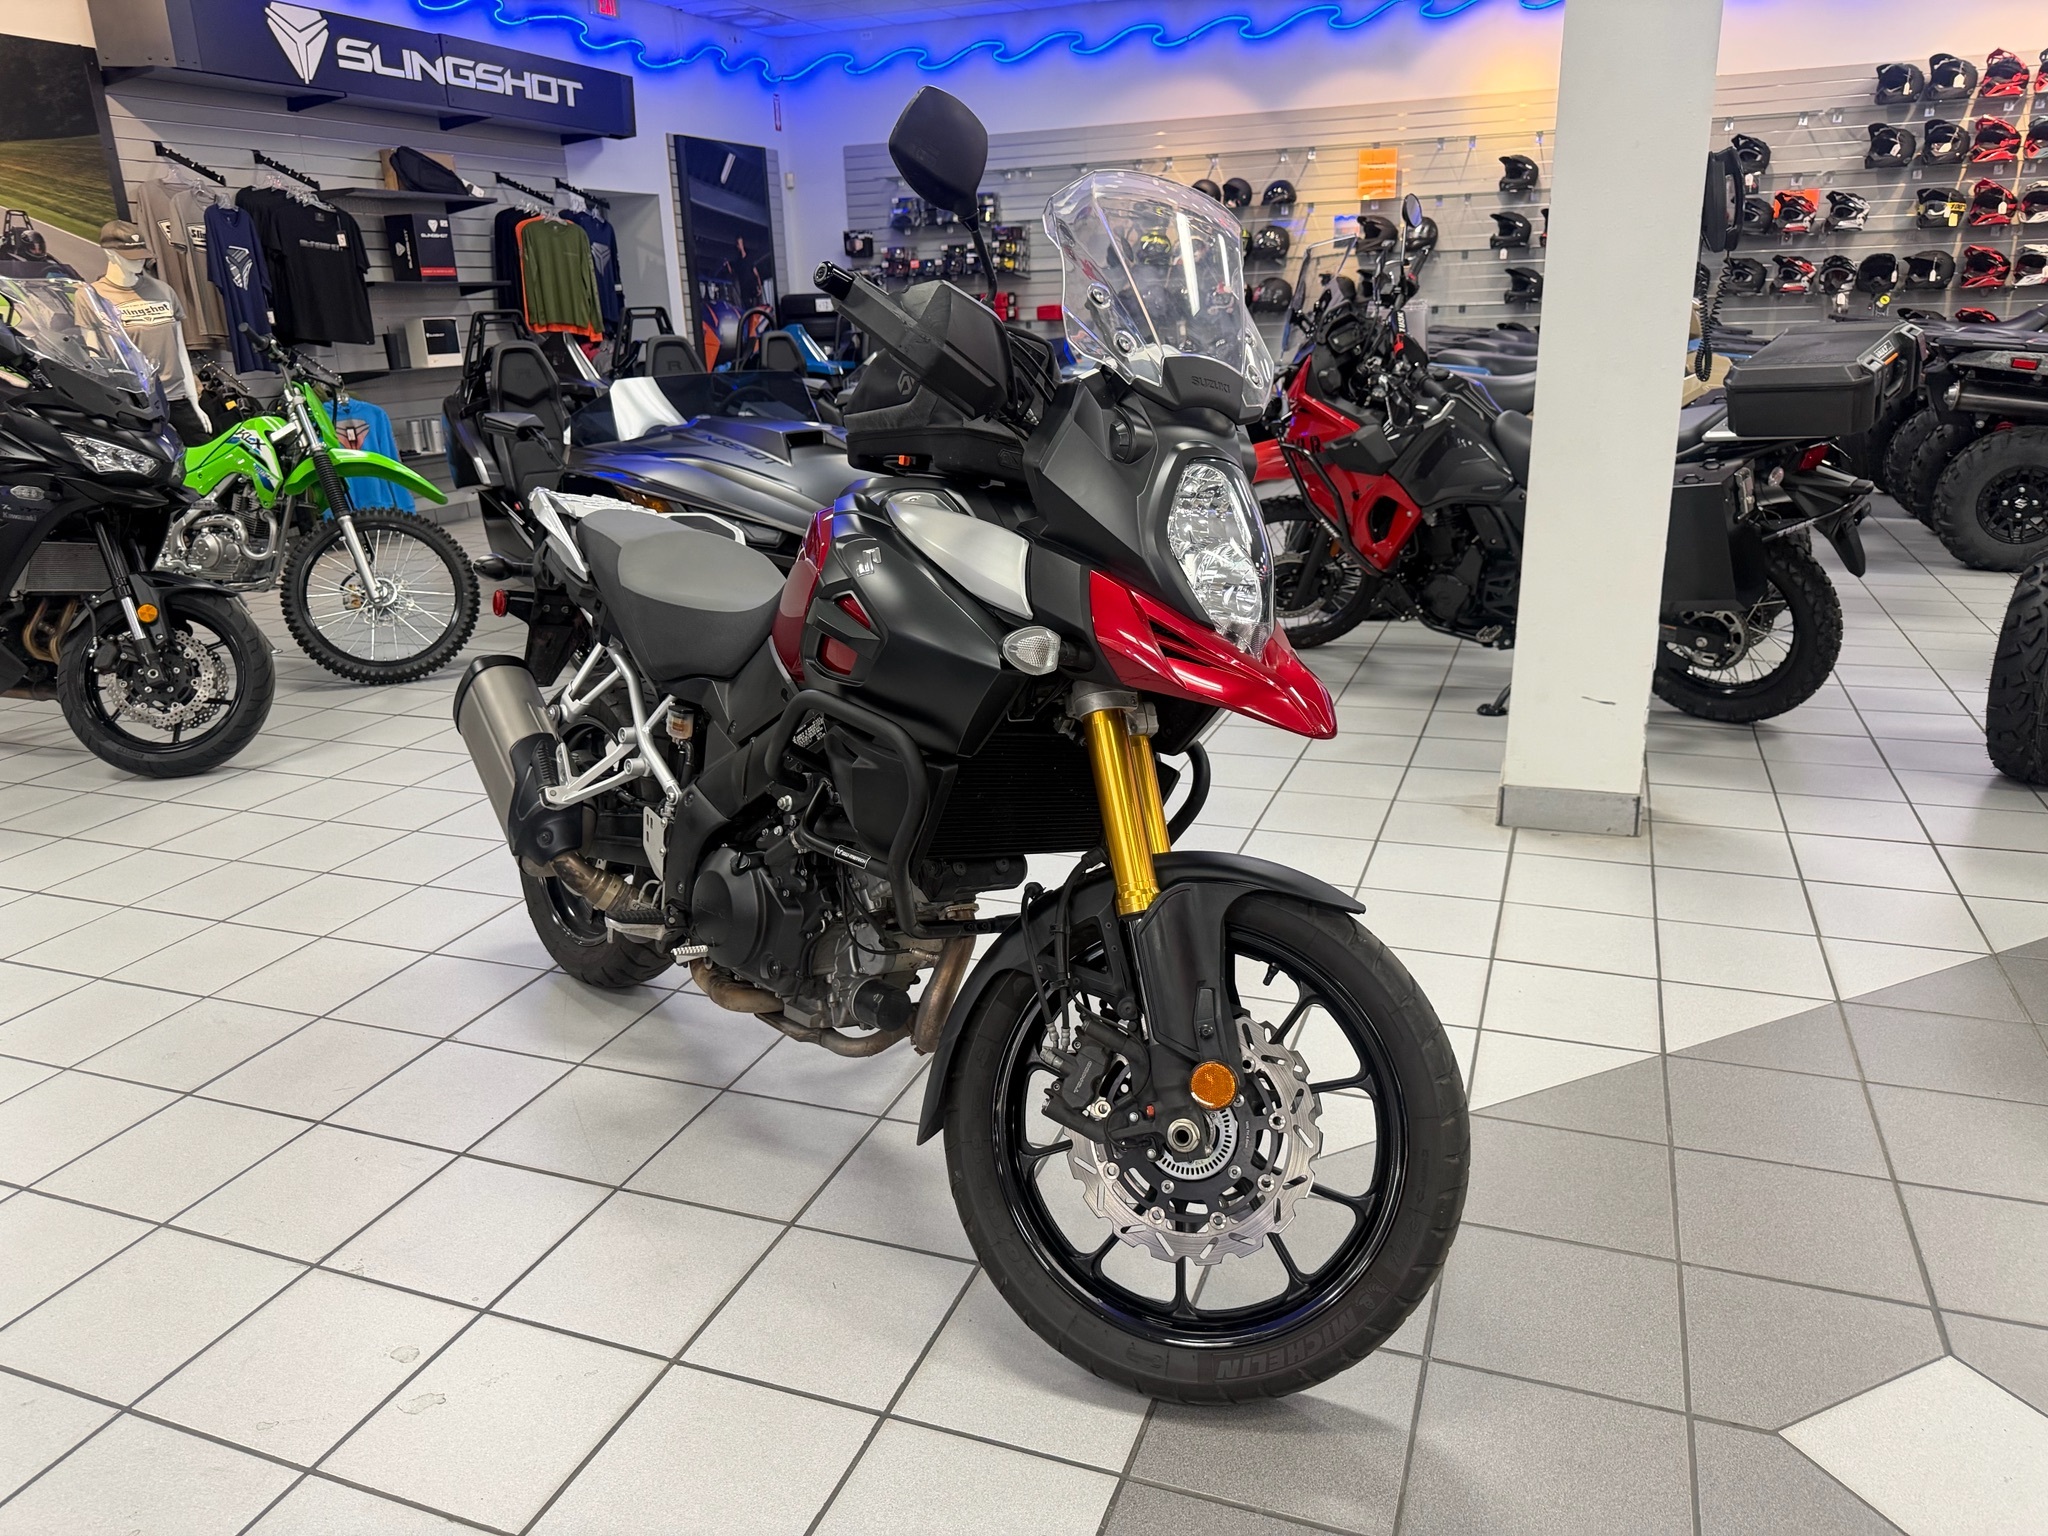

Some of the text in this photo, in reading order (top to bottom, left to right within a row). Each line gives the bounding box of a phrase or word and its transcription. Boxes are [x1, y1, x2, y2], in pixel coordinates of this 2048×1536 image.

[337, 37, 583, 107] SLINGSHOT
[1190, 375, 1231, 394] SUZUKI
[1216, 1310, 1358, 1380] MICHELIN
